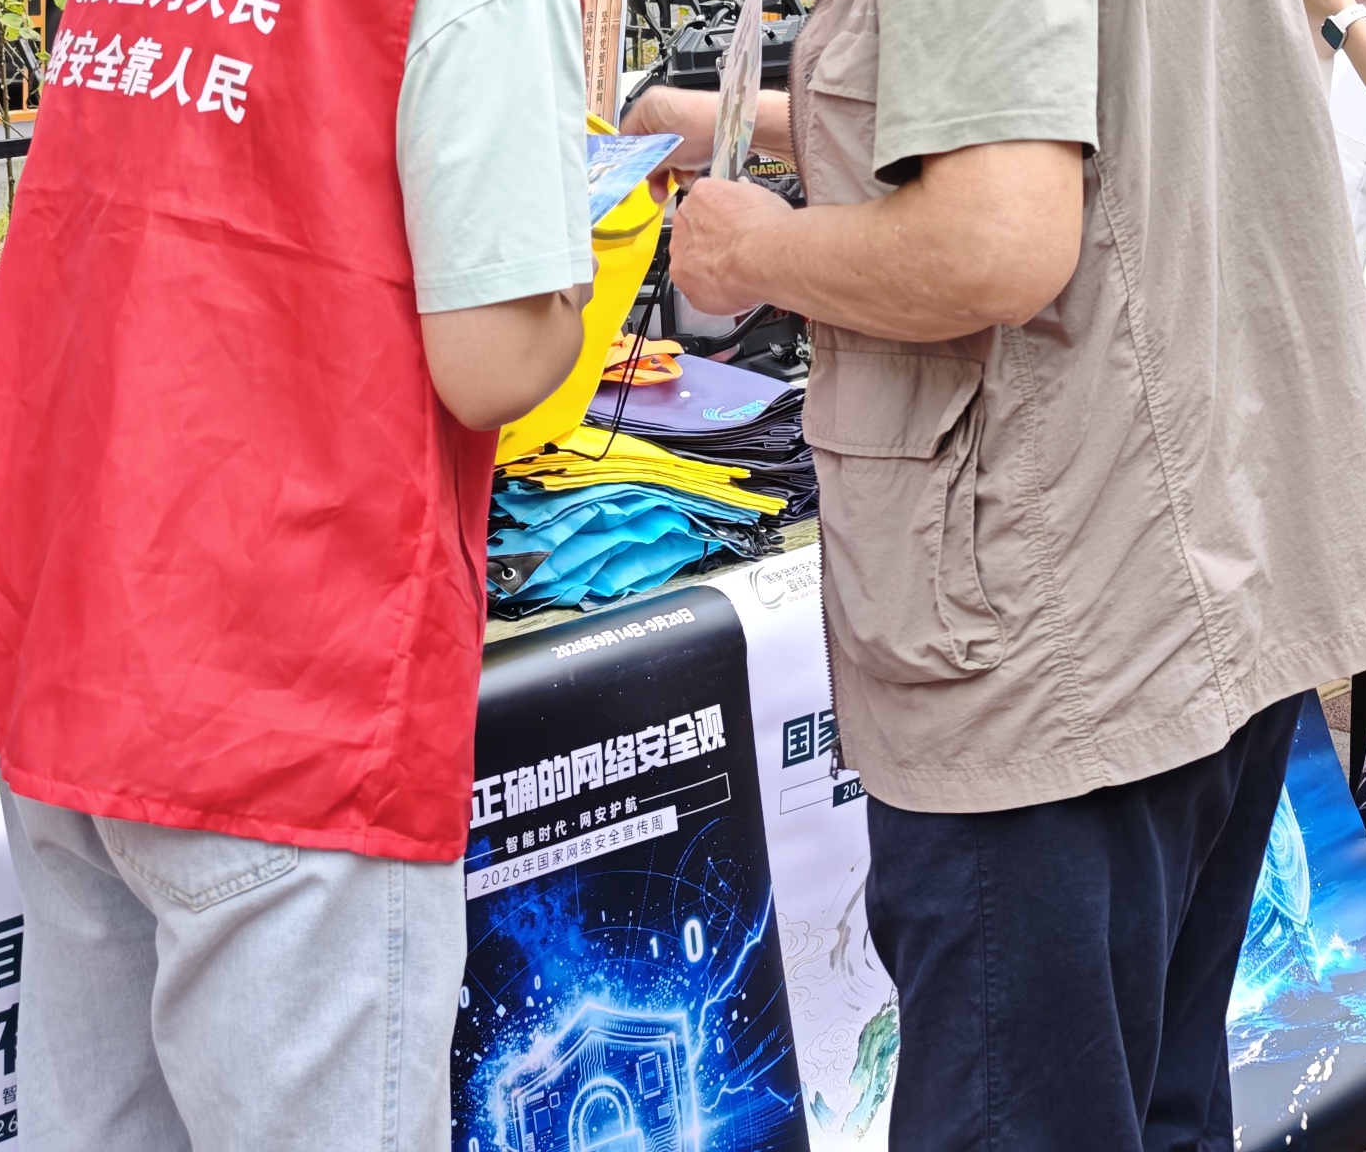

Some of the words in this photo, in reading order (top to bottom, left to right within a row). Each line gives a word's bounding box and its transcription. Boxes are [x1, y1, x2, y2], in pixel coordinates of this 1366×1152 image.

[551, 607, 696, 659] 2026年9月14日-9月20日
[469, 703, 727, 830] 正确的网络安全观
[481, 814, 664, 890] 2026年国家网络安全宣传周
[505, 795, 638, 855] 智能时代·网安护航
